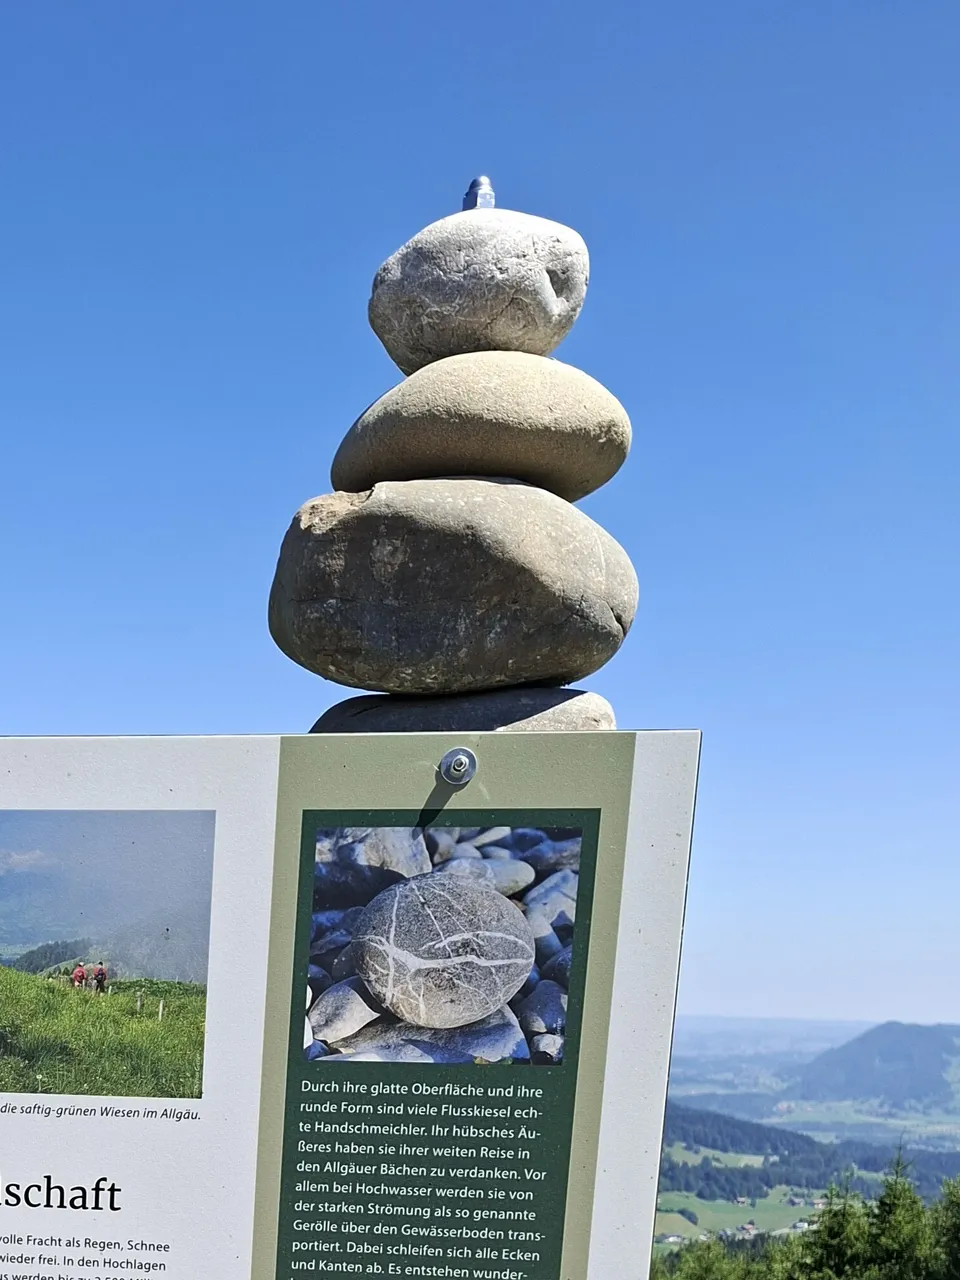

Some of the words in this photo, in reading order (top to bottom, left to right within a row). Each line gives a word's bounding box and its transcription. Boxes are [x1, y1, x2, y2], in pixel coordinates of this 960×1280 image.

[301, 1080, 339, 1092] Durch
[342, 1081, 368, 1094] ihre
[370, 1081, 408, 1097] glatte
[411, 1082, 484, 1096] Oberfläche
[487, 1084, 513, 1097] und
[517, 1085, 543, 1098] ihre
[0, 1102, 17, 1114] die
[19, 1102, 96, 1118] saftig-grünen
[100, 1106, 140, 1118] Wiesen
[142, 1107, 158, 1118] im
[159, 1108, 200, 1122] Allgäu.
[300, 1100, 338, 1113] runde
[340, 1101, 373, 1114] Form
[376, 1102, 404, 1114] sind
[407, 1103, 438, 1116] viele
[441, 1104, 511, 1118] Flusskiesel
[513, 1106, 543, 1118] ech-
[298, 1121, 311, 1132] te
[314, 1121, 428, 1136] Handschmeichler.
[431, 1124, 449, 1136] Ihr
[452, 1123, 514, 1138] hübsches
[517, 1124, 541, 1139] Äu-
[297, 1139, 331, 1153] ßeres
[334, 1141, 374, 1154] haben
[378, 1143, 396, 1155] sie
[398, 1143, 429, 1156] ihrer
[432, 1145, 476, 1158] weiten
[479, 1146, 514, 1159] Reise
[517, 1147, 530, 1159] in
[26, 1234, 62, 1247] Fracht
[65, 1236, 81, 1248] als
[83, 1237, 124, 1252] Regen,
[127, 1239, 170, 1252] Schnee
[38, 1253, 60, 1266] frei.
[63, 1255, 74, 1266] In
[77, 1256, 99, 1267] den
[103, 1257, 166, 1273] Hochlagen
